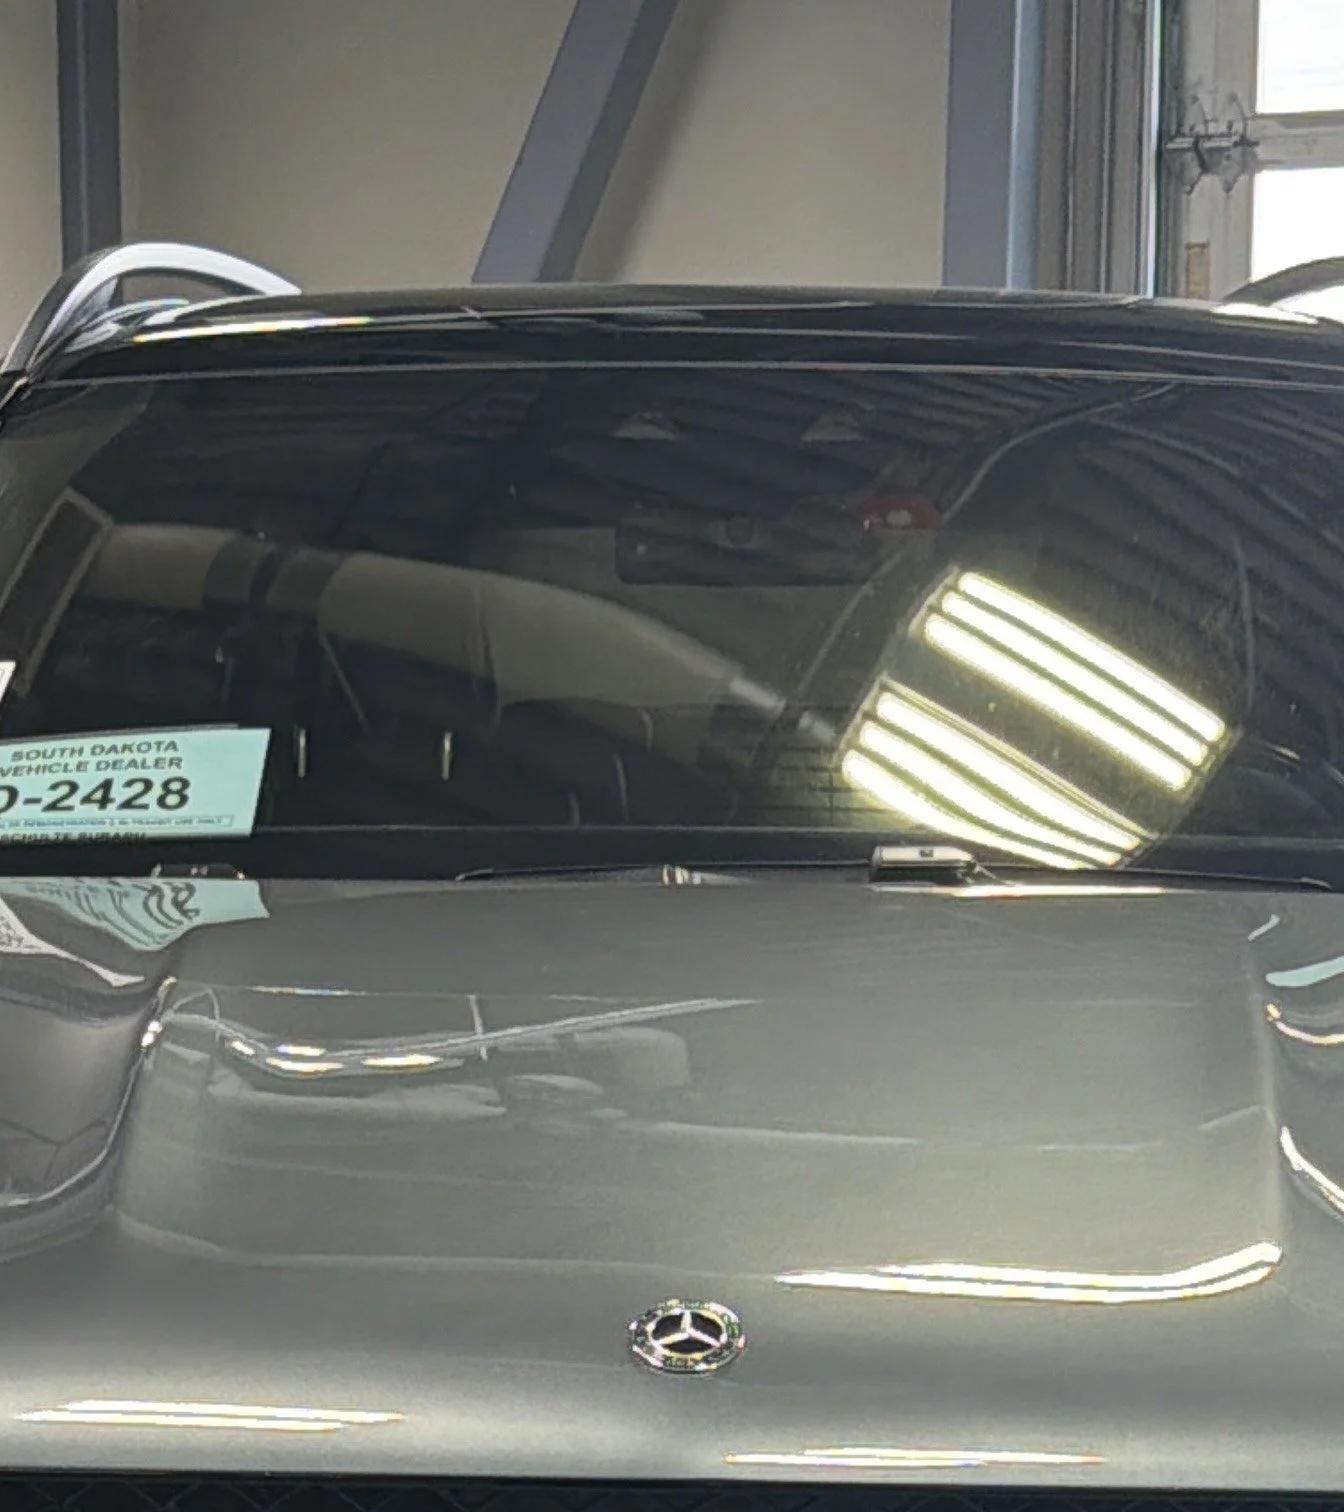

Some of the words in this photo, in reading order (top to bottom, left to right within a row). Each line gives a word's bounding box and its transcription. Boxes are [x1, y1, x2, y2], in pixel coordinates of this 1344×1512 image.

[10, 745, 84, 763] SOUTH
[90, 739, 180, 756] DAKOTA
[96, 756, 183, 773] DEALER
